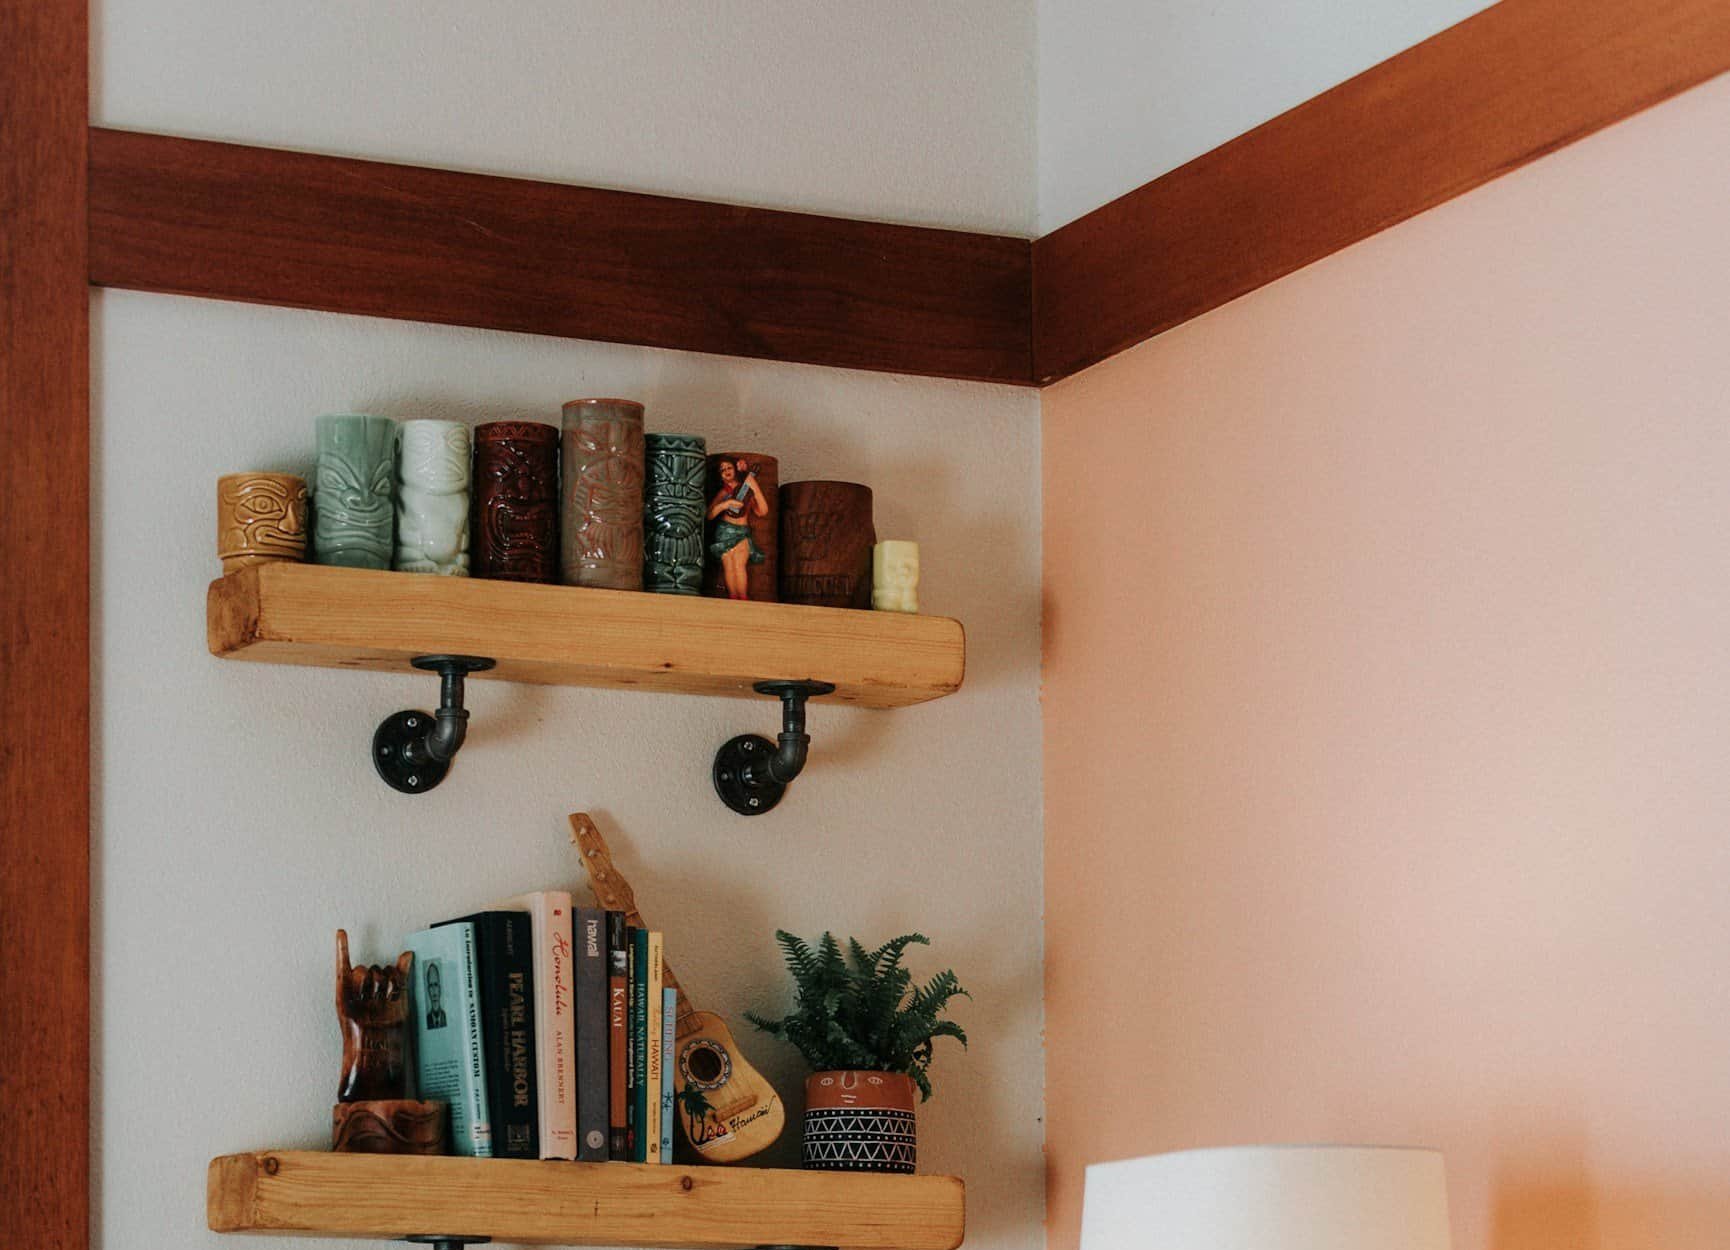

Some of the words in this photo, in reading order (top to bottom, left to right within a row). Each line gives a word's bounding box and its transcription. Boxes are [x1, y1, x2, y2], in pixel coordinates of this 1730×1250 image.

[587, 919, 599, 957] hawaii
[552, 932, 569, 1016] Honolulu
[470, 1002, 478, 1039] SAMOAN
[508, 972, 527, 1026] PEARL
[472, 1041, 480, 1078] CUSTOM
[555, 1030, 563, 1054] ALAN
[636, 1026, 645, 1087] NATURALLY
[511, 1030, 529, 1107] HARBOR
[556, 1057, 565, 1105] BRENNERT
